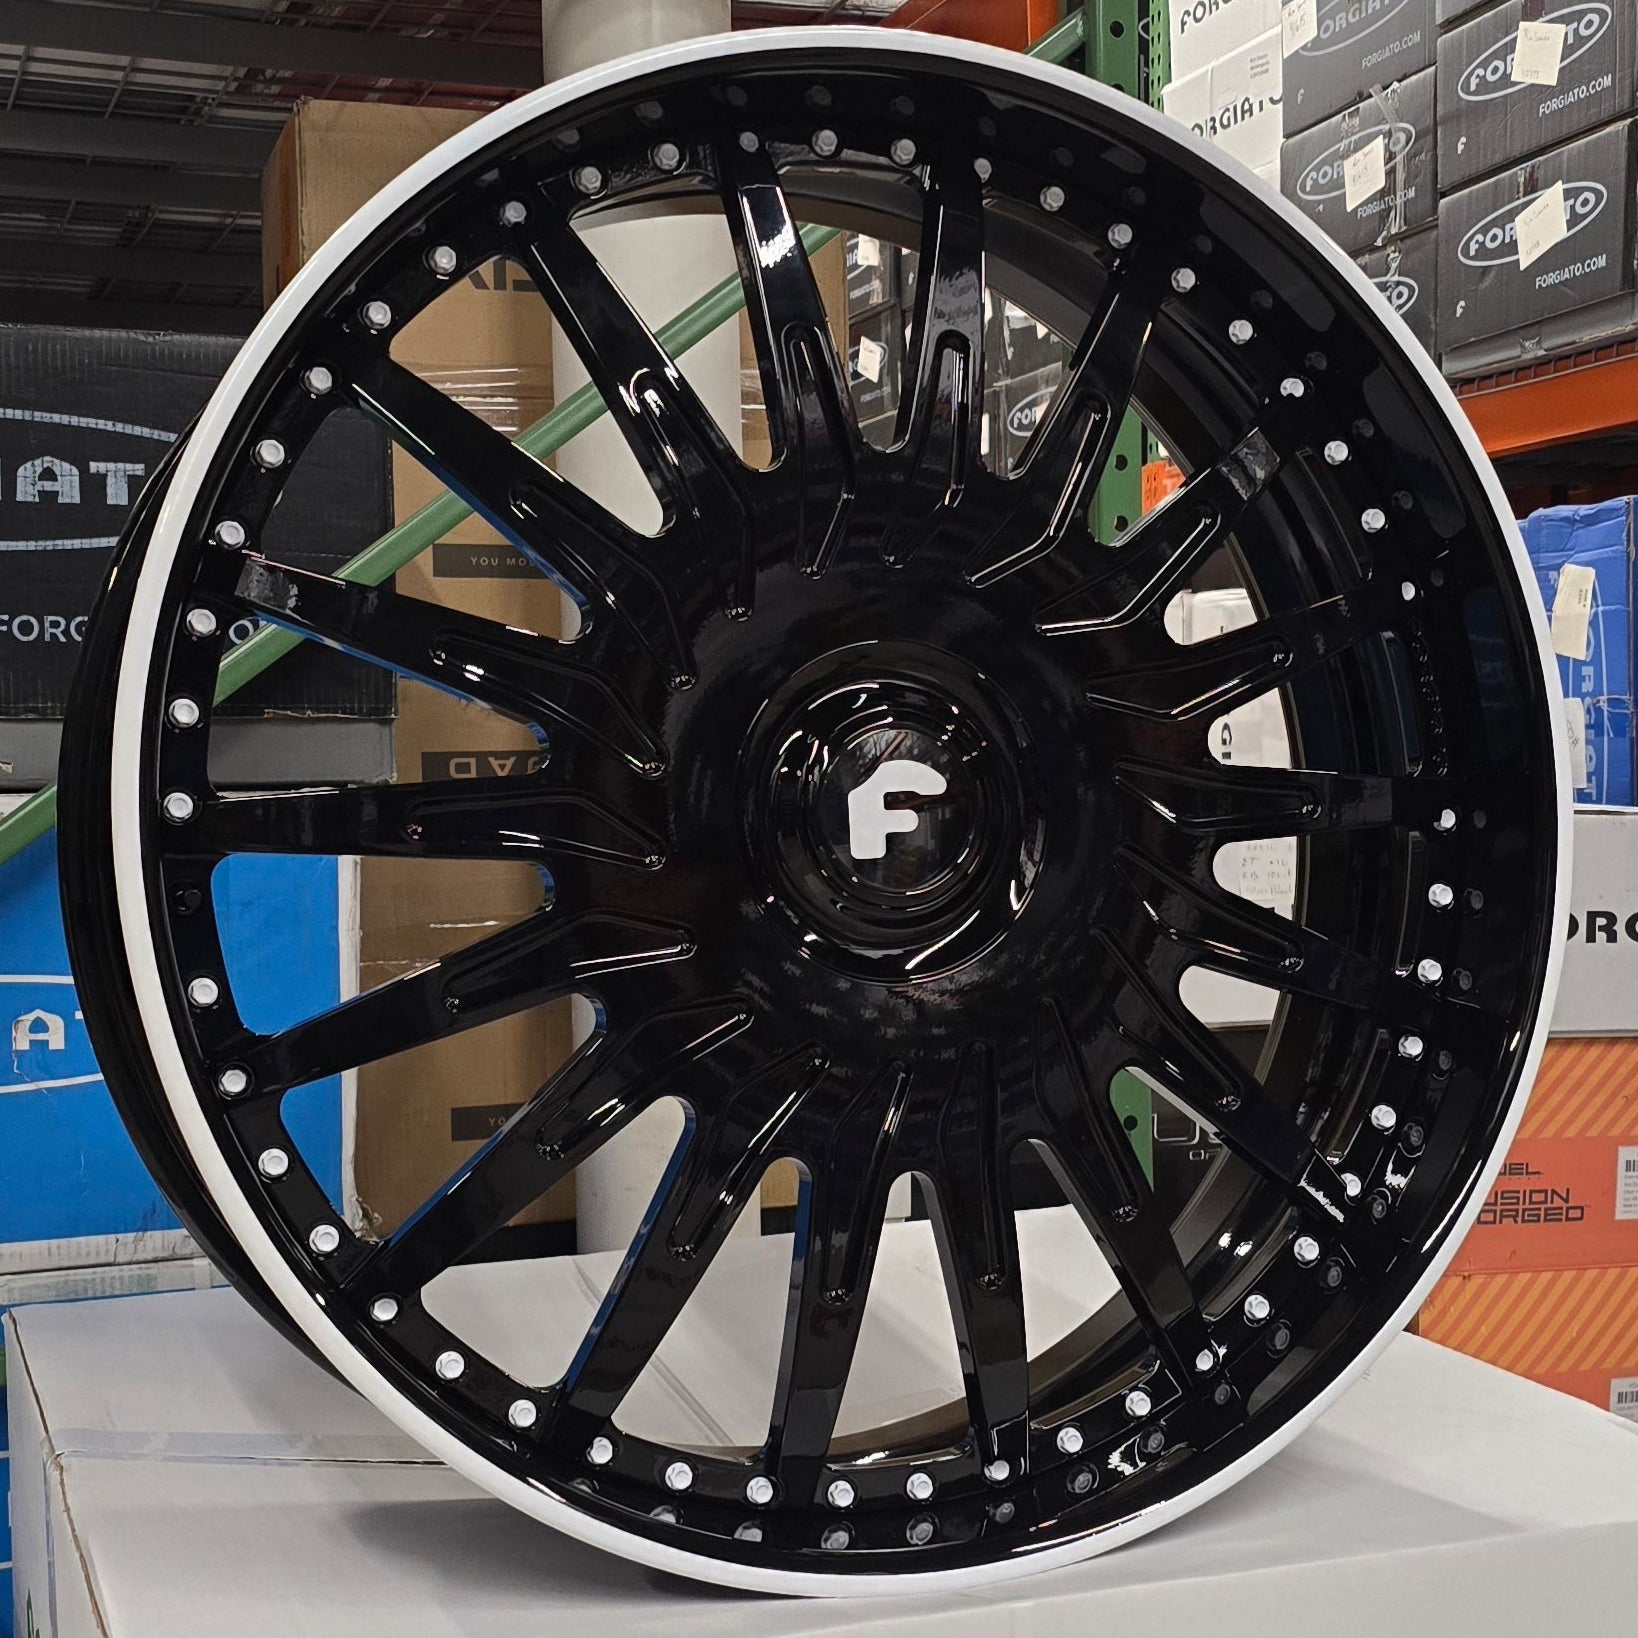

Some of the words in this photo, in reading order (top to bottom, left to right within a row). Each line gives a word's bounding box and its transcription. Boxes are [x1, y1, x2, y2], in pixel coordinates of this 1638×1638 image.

[1361, 30, 1421, 69] FORGIATO.COM
[1539, 74, 1612, 117] FORGIATO.COM
[1535, 254, 1607, 290] FORGIATO.COM
[470, 556, 499, 566] YOU
[1477, 1205, 1585, 1225] ORGED
